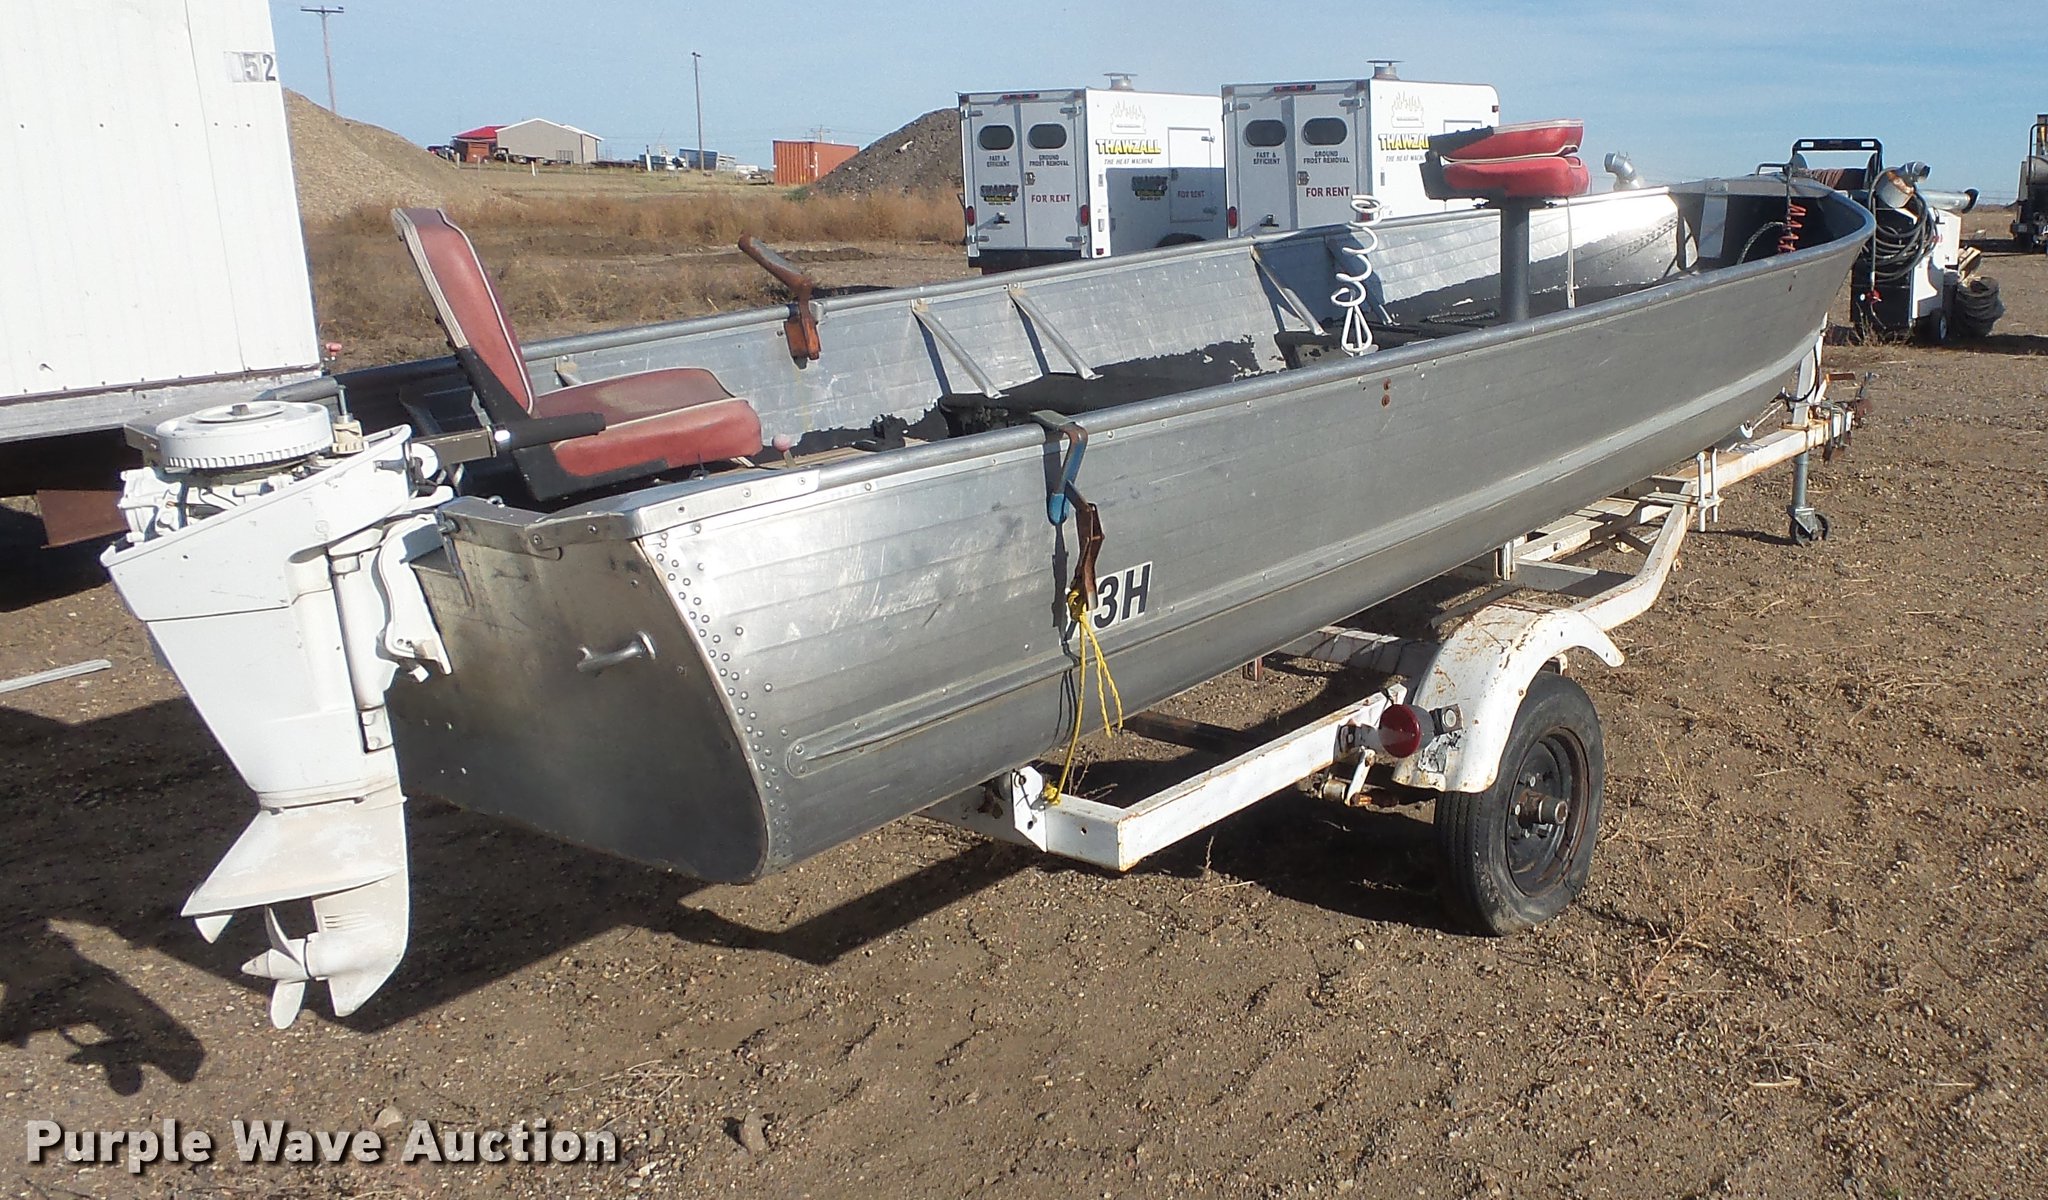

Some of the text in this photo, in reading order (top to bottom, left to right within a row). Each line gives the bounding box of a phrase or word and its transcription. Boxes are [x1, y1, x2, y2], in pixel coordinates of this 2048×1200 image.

[243, 53, 276, 81] 52
[1095, 139, 1162, 154] THAWZALL
[1177, 190, 1189, 198] FOR
[1306, 187, 1350, 197] FOR RENT
[1031, 194, 1071, 203] FOR RENT
